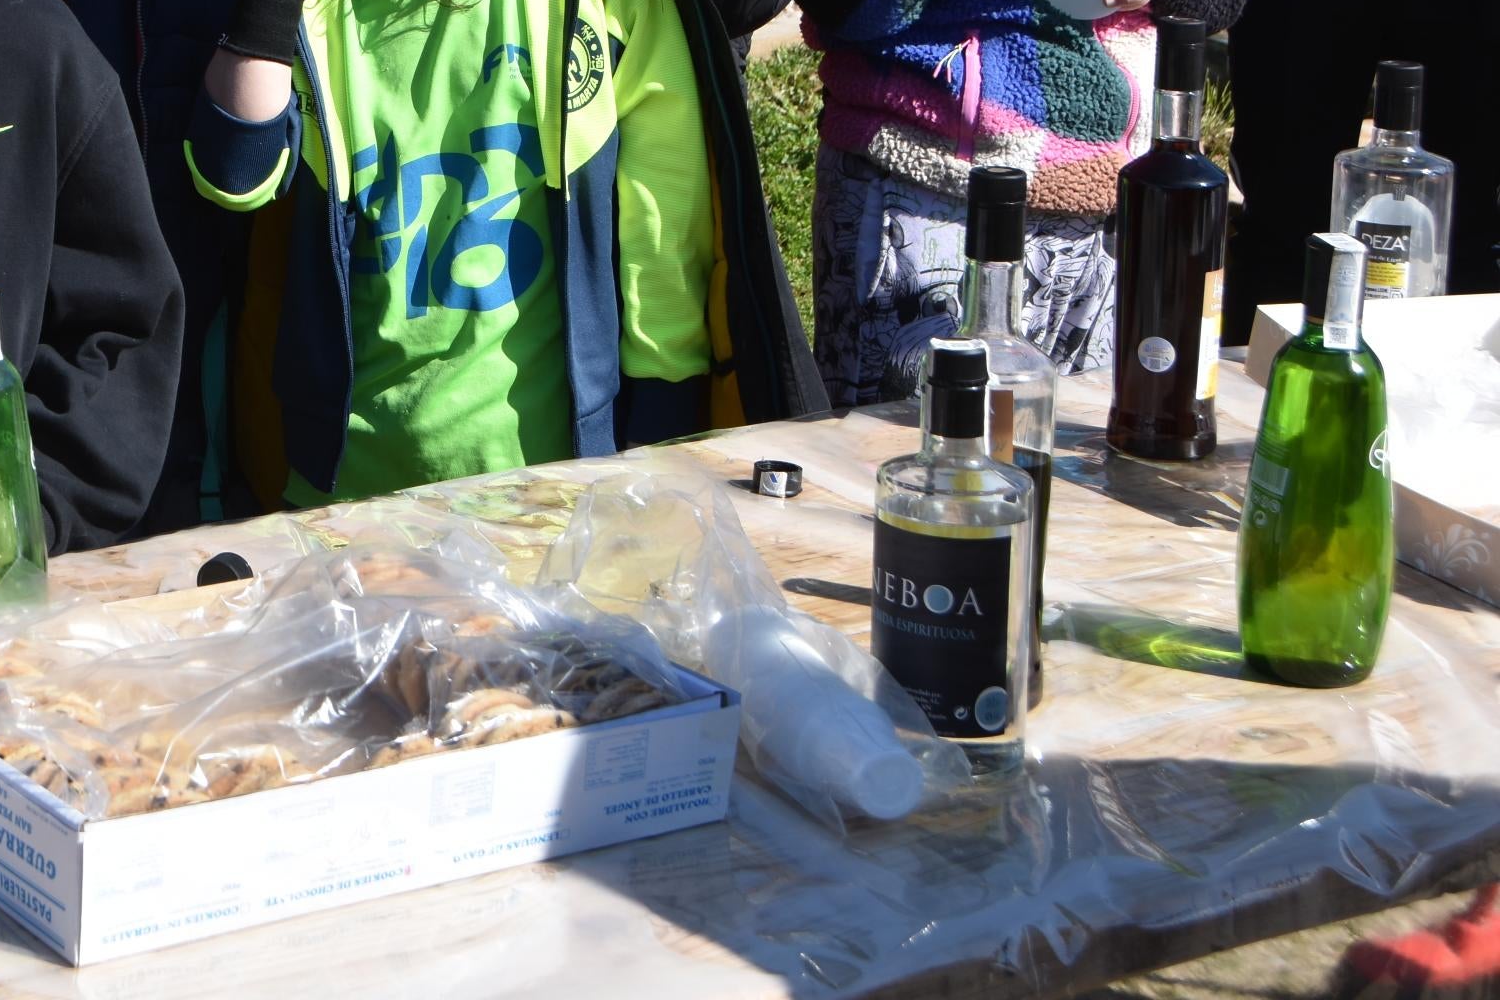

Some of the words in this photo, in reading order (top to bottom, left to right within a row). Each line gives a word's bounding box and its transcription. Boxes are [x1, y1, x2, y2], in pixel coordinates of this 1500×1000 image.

[573, 77, 599, 109] MARTA
[897, 616, 976, 640] ESPIRITUOSA
[643, 795, 659, 807] DE
[660, 785, 713, 801] CABELLO
[624, 811, 650, 825] CON
[651, 797, 710, 818] HOJALDRE
[13, 812, 33, 835] SAN
[506, 829, 560, 851] LENGUAS
[337, 879, 353, 892] DE
[354, 866, 404, 888] COOKIES
[185, 905, 240, 927] COOKIES
[101, 918, 182, 945] INEGRALES
